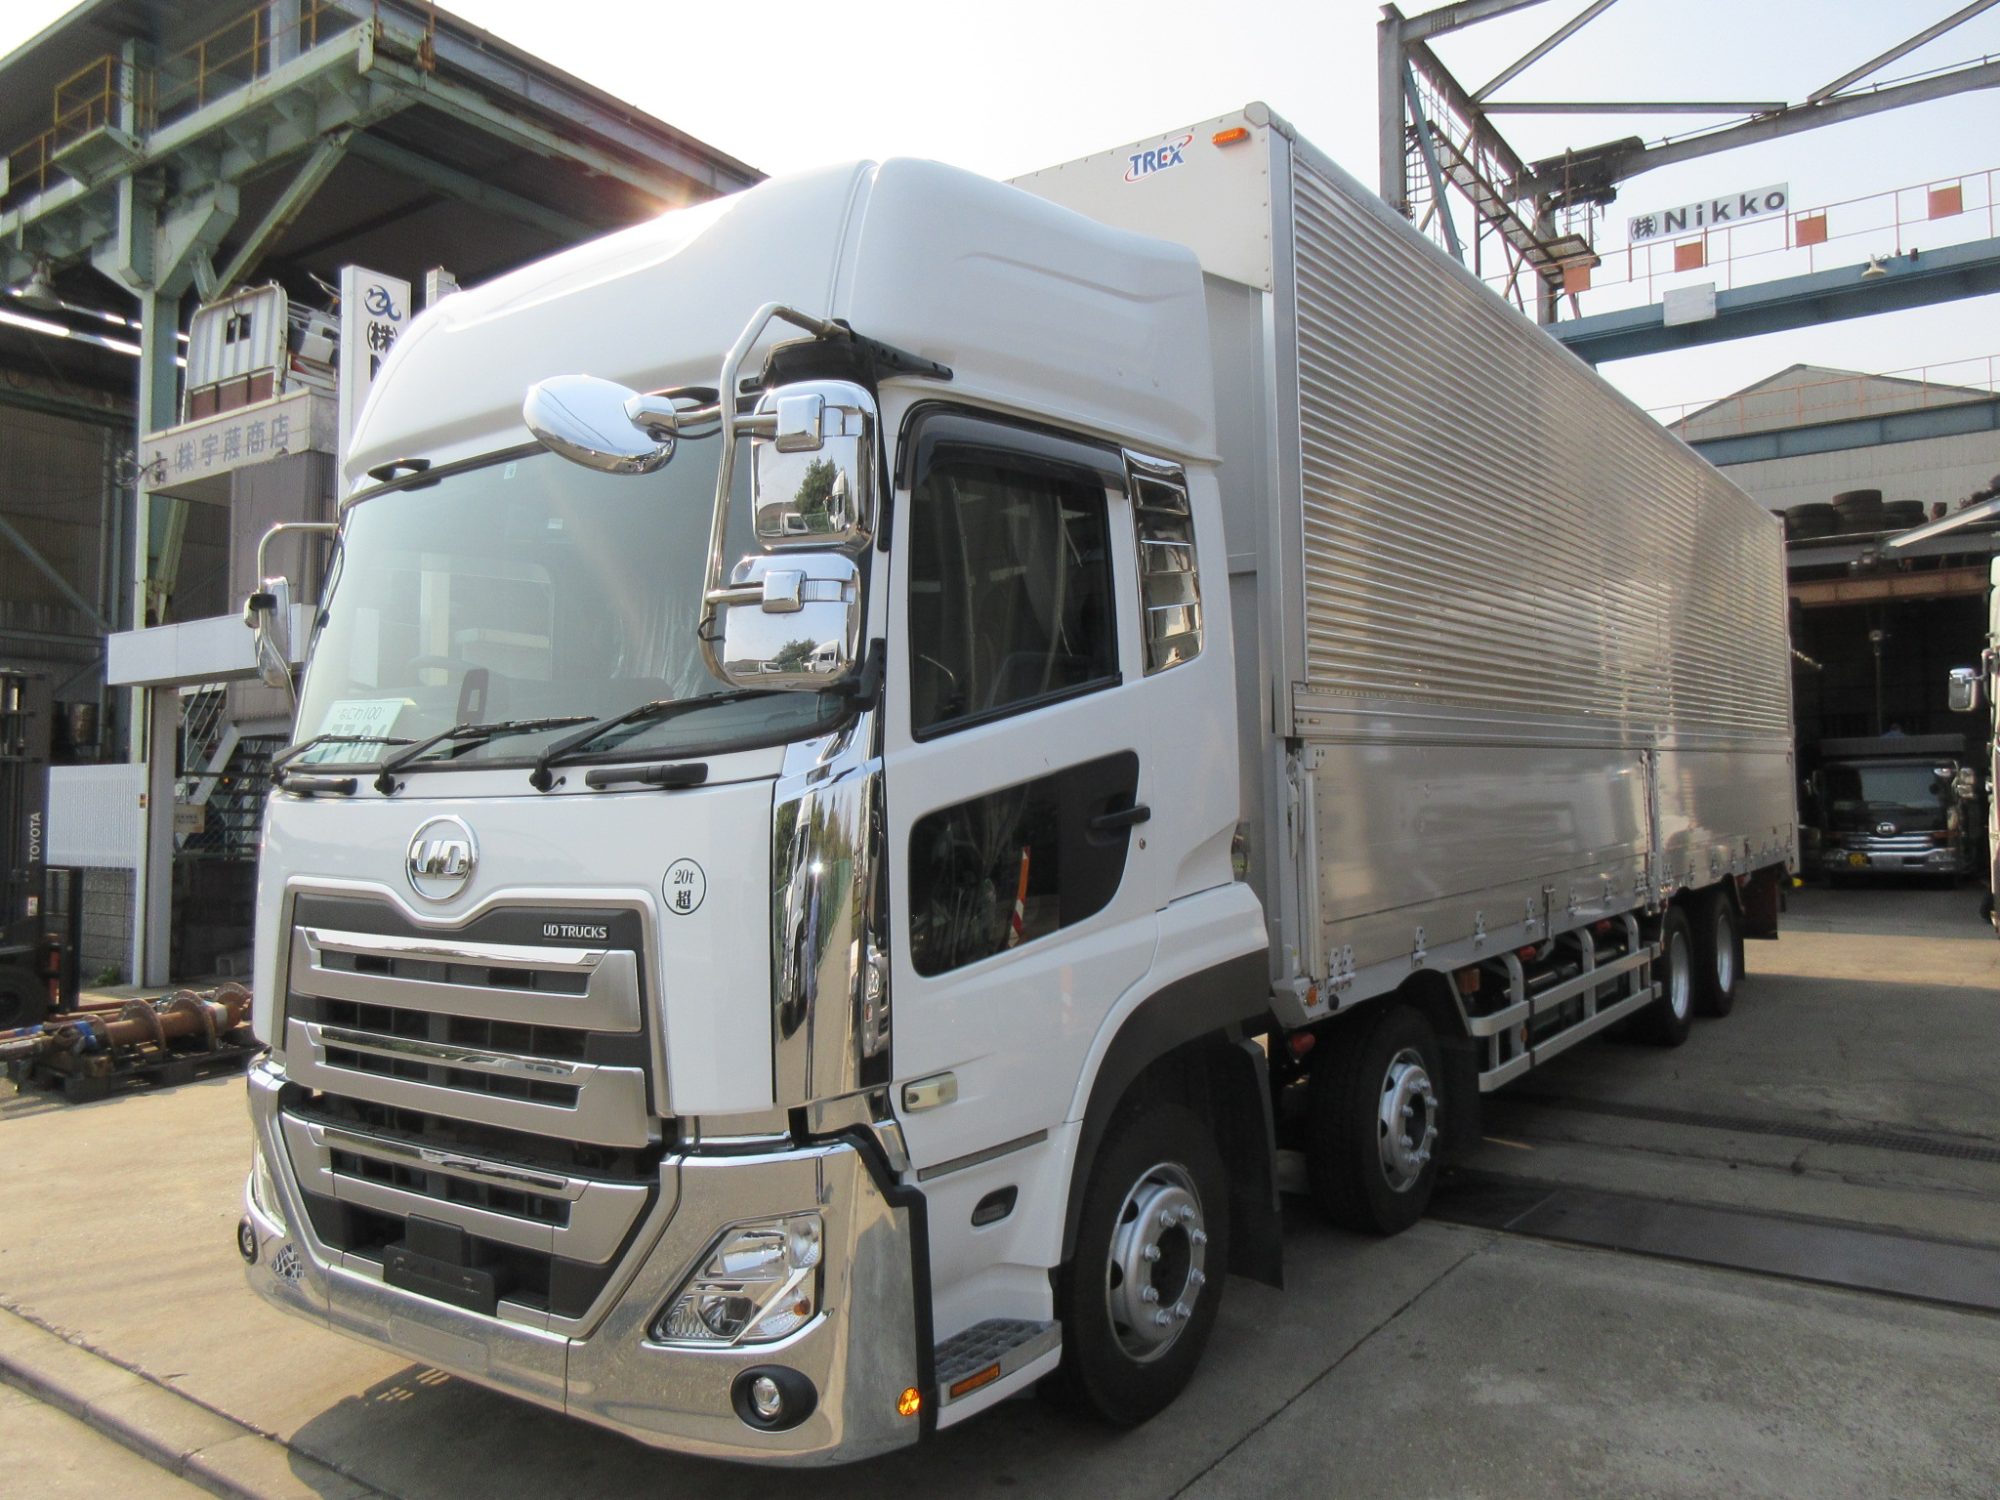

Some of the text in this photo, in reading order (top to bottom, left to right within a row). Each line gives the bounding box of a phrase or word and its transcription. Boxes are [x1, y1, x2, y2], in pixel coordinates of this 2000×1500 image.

[1129, 142, 1185, 177] TREX
[29, 811, 41, 863] TOYOTA
[410, 839, 470, 880] UD
[674, 869, 695, 885] 20t
[675, 889, 692, 910] 超
[543, 924, 608, 940] UD TRUCKS
